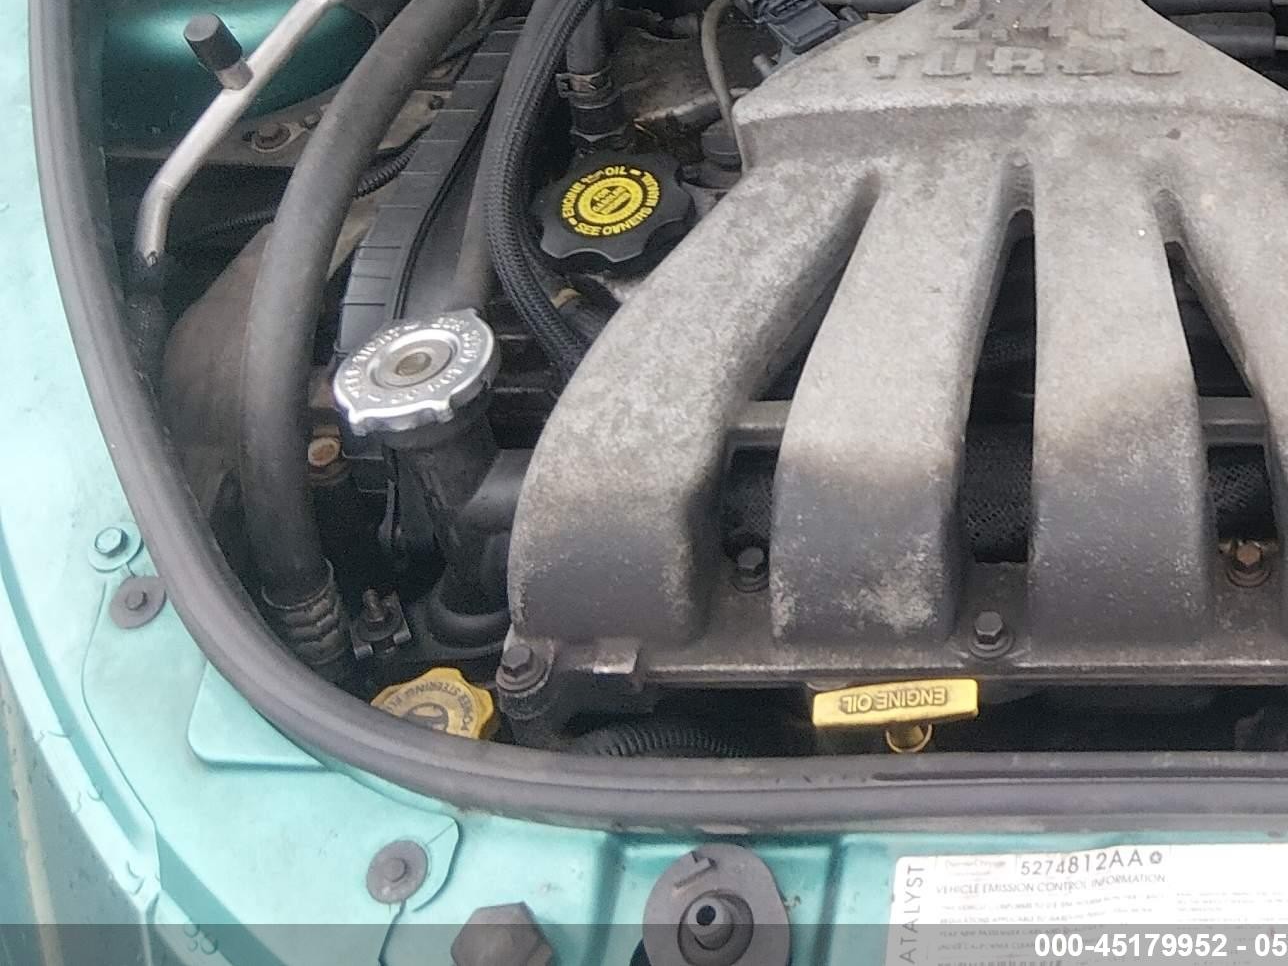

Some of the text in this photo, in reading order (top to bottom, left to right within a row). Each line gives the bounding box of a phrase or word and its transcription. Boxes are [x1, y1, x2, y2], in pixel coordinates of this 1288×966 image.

[865, 45, 1183, 79] TURBO
[841, 686, 949, 714] ENGINE OIL
[1020, 849, 1144, 876] 5274812AA
[983, 882, 1034, 894] EMISSION
[899, 865, 925, 964] ATALYST
